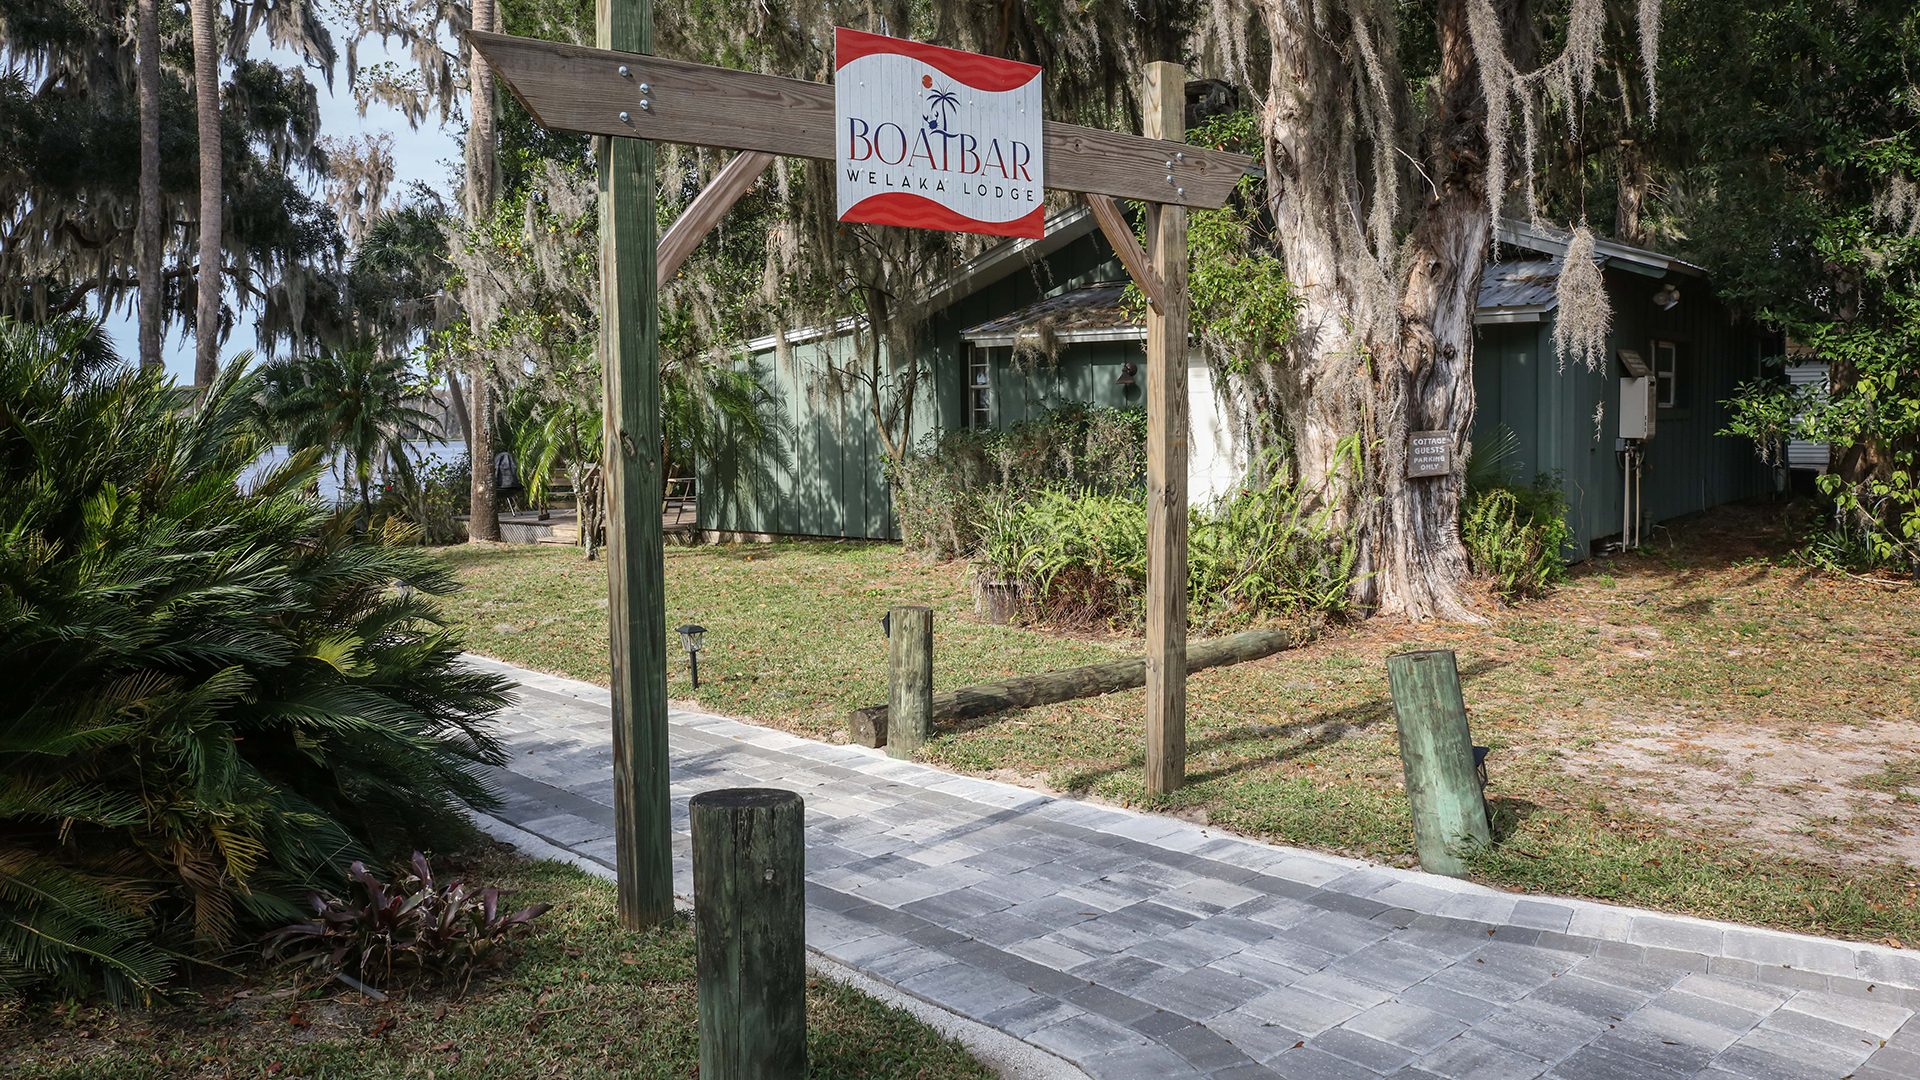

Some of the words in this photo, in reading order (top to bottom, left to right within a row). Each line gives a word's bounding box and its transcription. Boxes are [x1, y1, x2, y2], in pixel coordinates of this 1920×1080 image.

[847, 168, 945, 192] WELAKA
[963, 182, 1034, 202] LODGE
[1413, 437, 1446, 446] COTTAGE
[1414, 446, 1445, 454] GUESTS
[1413, 455, 1445, 463] PARKING
